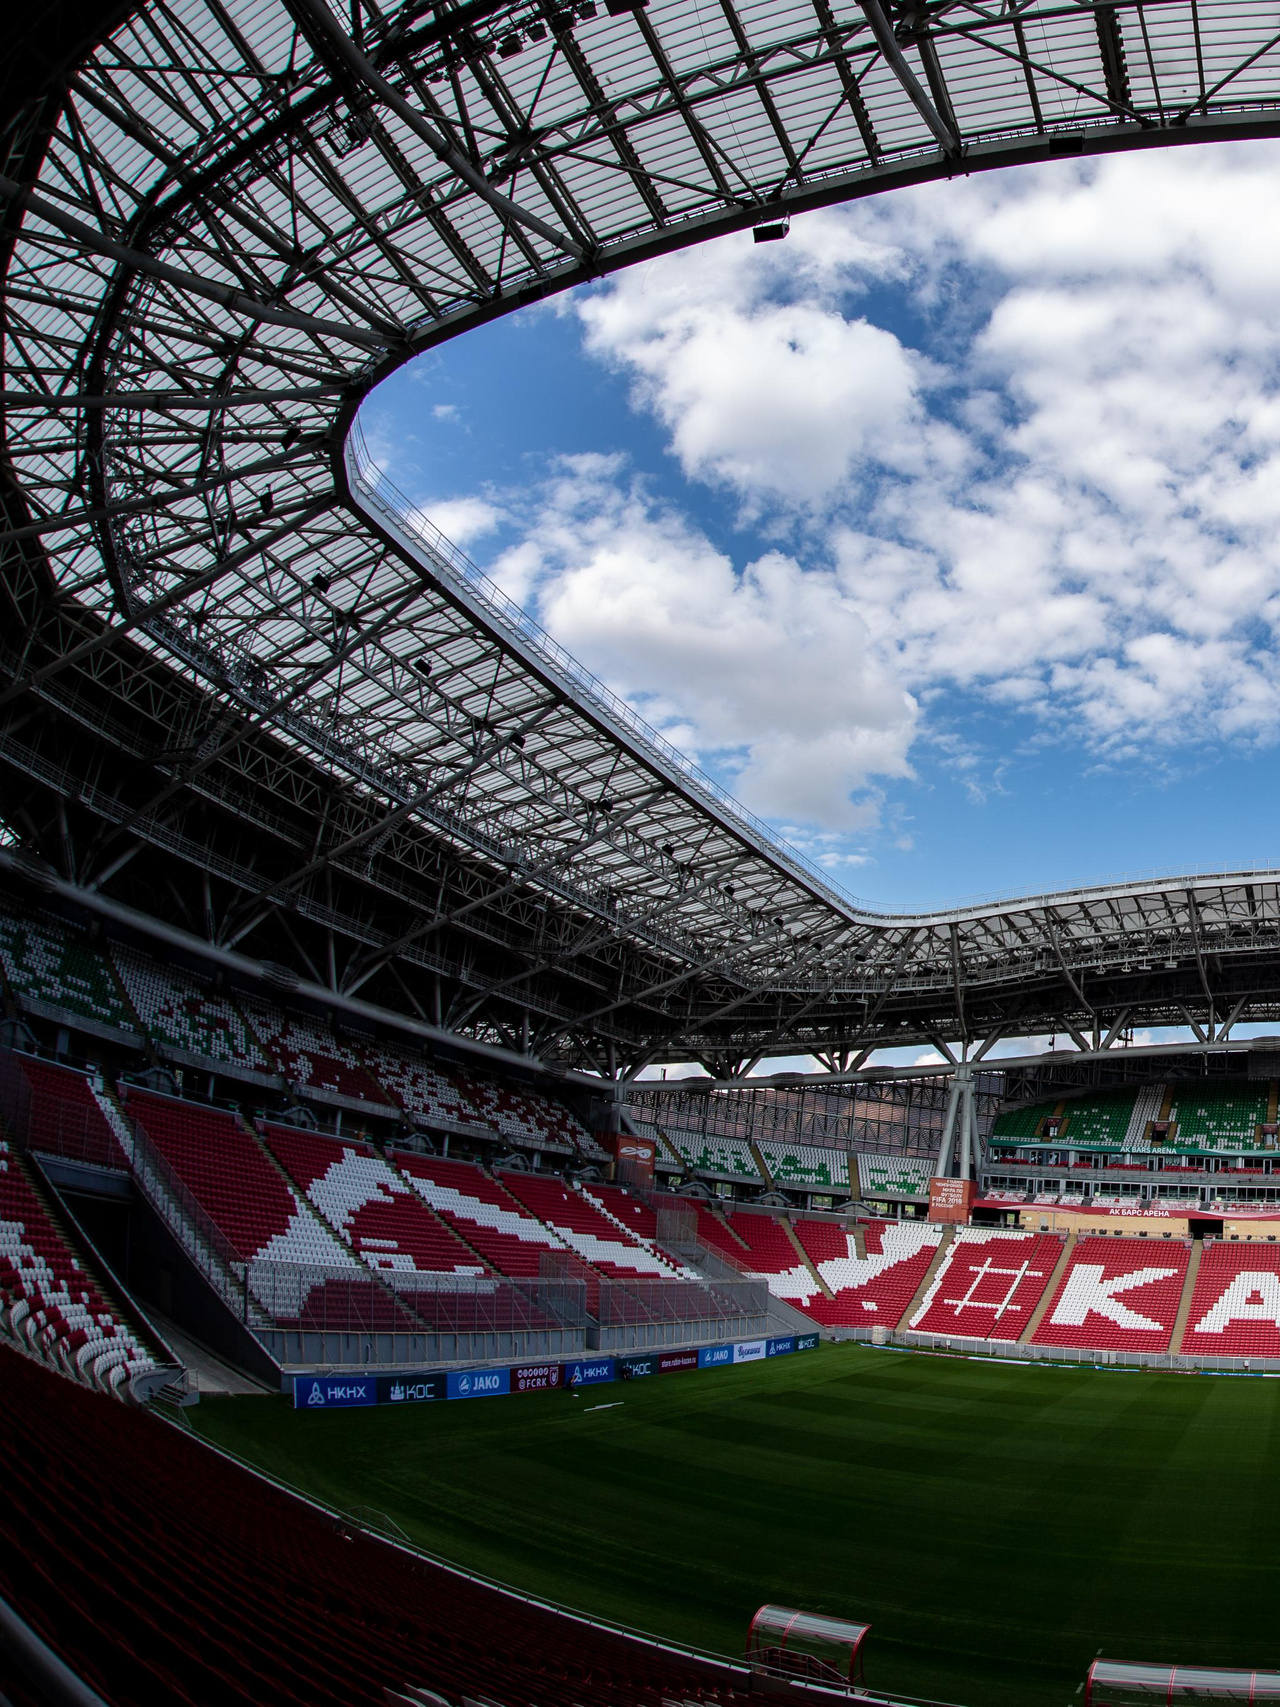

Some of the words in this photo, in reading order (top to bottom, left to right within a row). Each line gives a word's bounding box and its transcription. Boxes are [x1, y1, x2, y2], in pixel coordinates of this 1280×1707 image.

[713, 1350, 728, 1361] JAKO
[473, 1376, 499, 1391] JAKO
[518, 1377, 547, 1390] @FCRK
